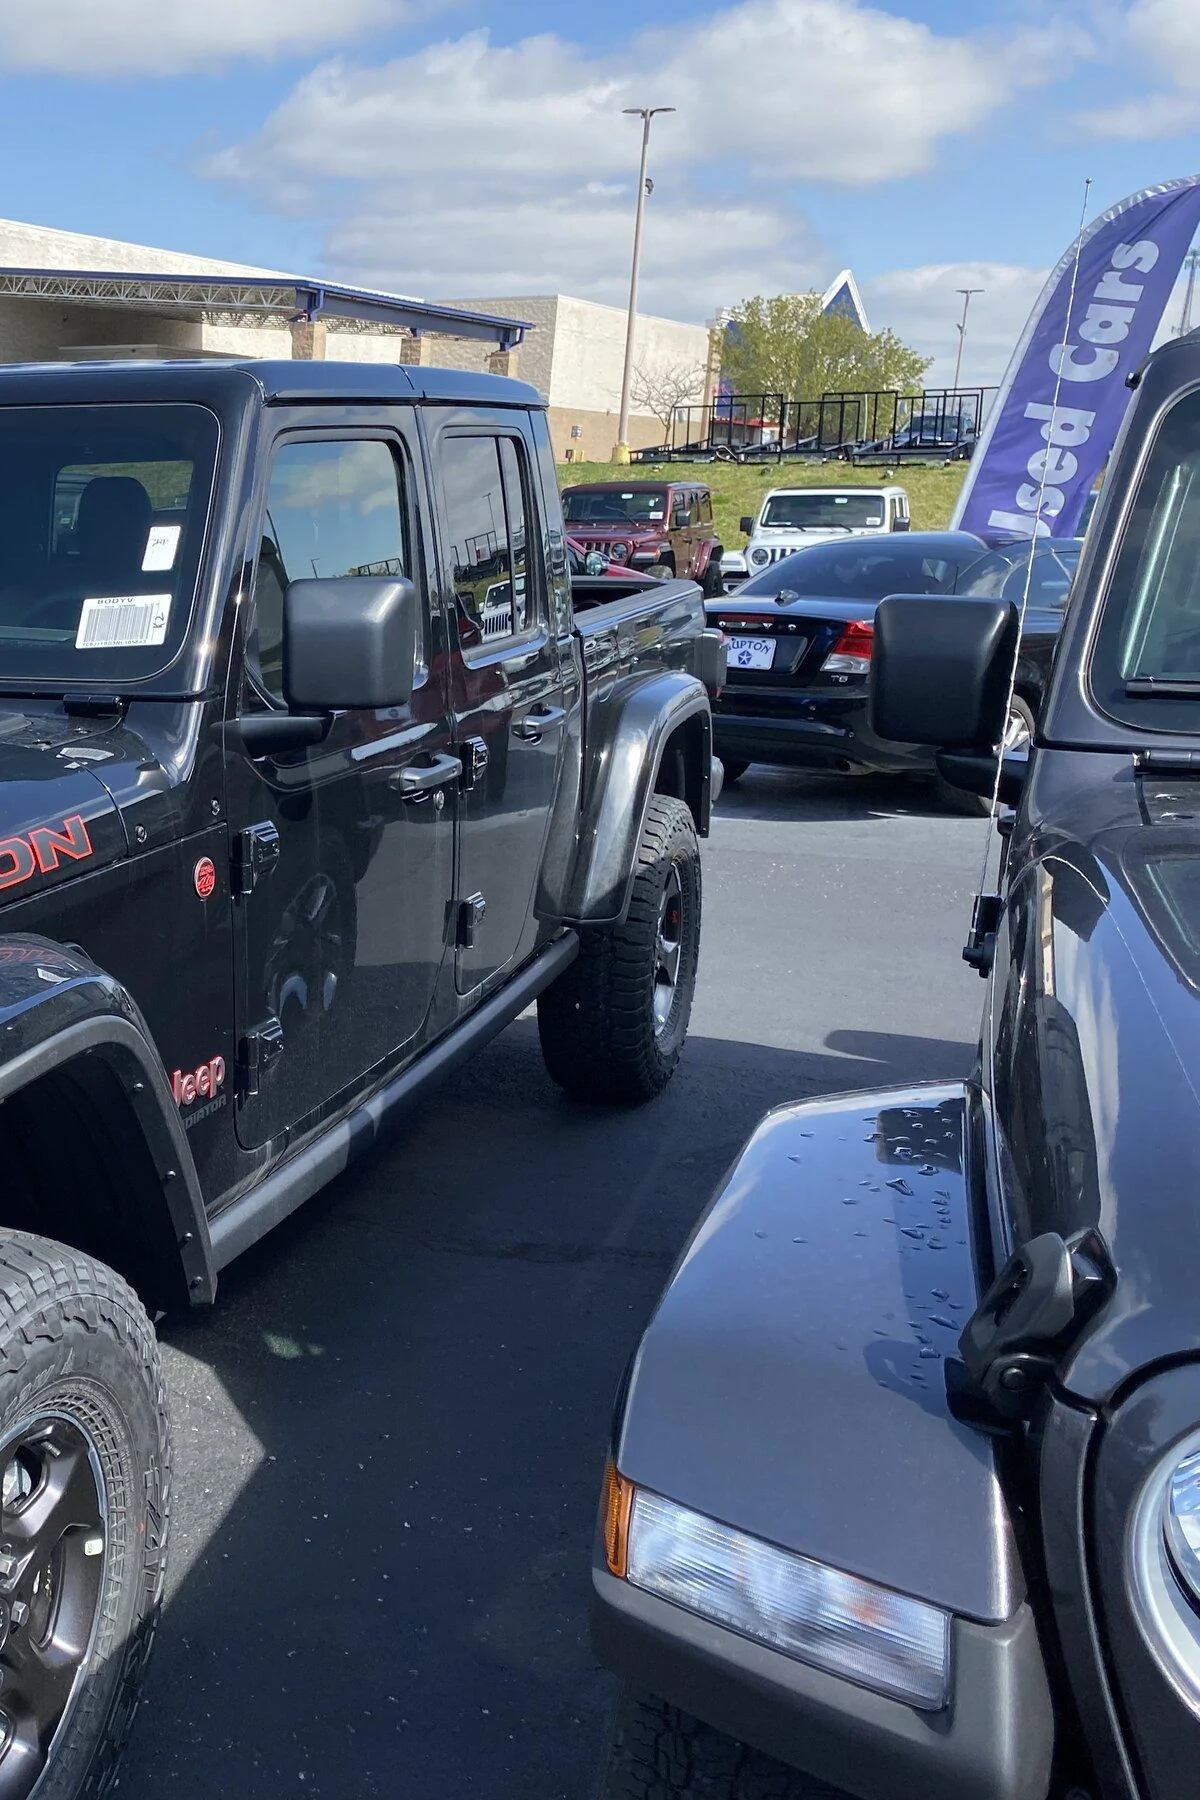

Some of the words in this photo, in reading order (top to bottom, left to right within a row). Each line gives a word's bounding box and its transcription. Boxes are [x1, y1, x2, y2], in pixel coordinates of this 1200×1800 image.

[1049, 240, 1159, 382] Cars
[173, 1056, 226, 1108] Jeep
[184, 1094, 227, 1130] DIATOR
